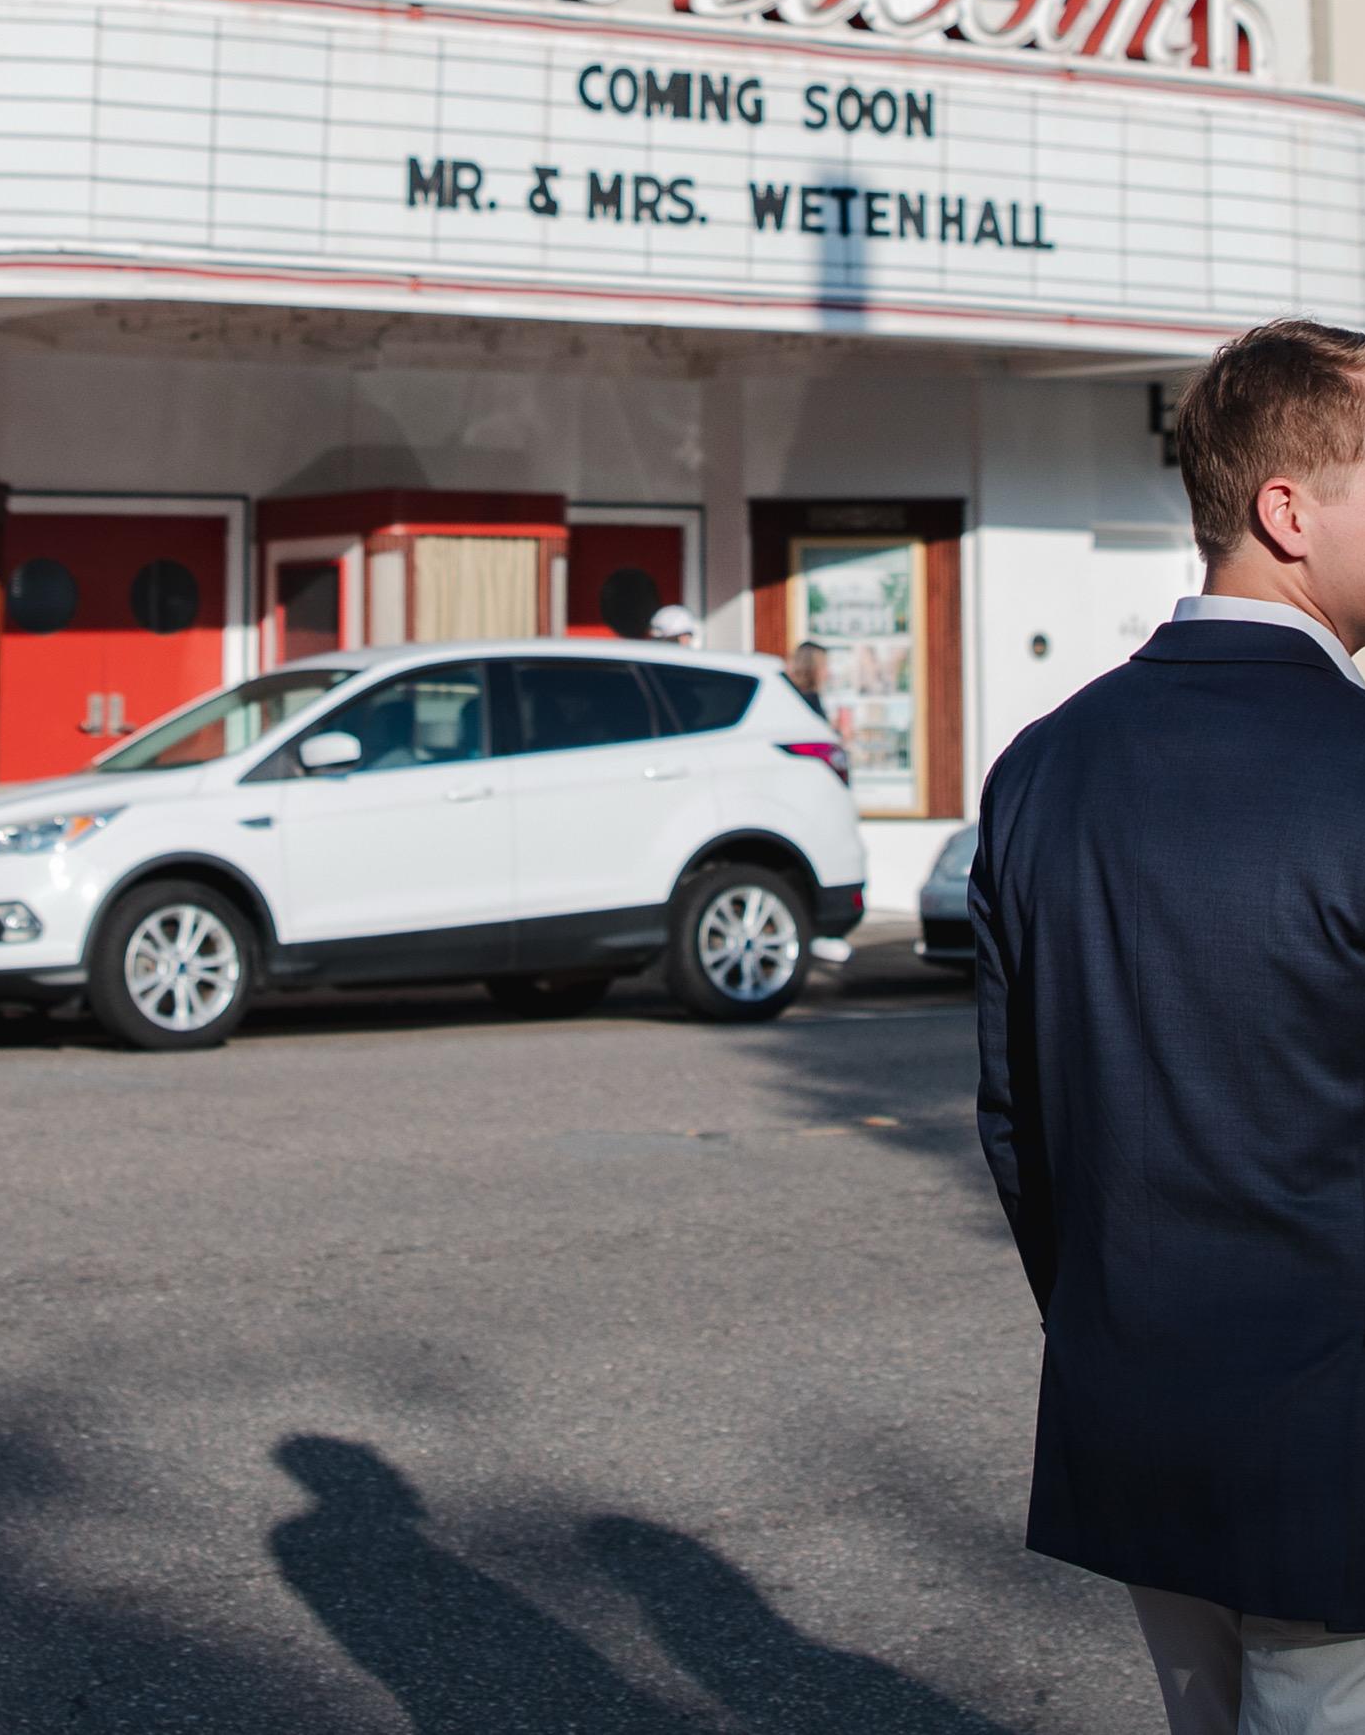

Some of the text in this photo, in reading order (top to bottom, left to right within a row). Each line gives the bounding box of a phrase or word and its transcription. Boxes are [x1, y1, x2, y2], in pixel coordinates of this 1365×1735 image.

[578, 64, 934, 137] COMING SOON
[408, 155, 1054, 250] MR. & MRS. WETENHALL
